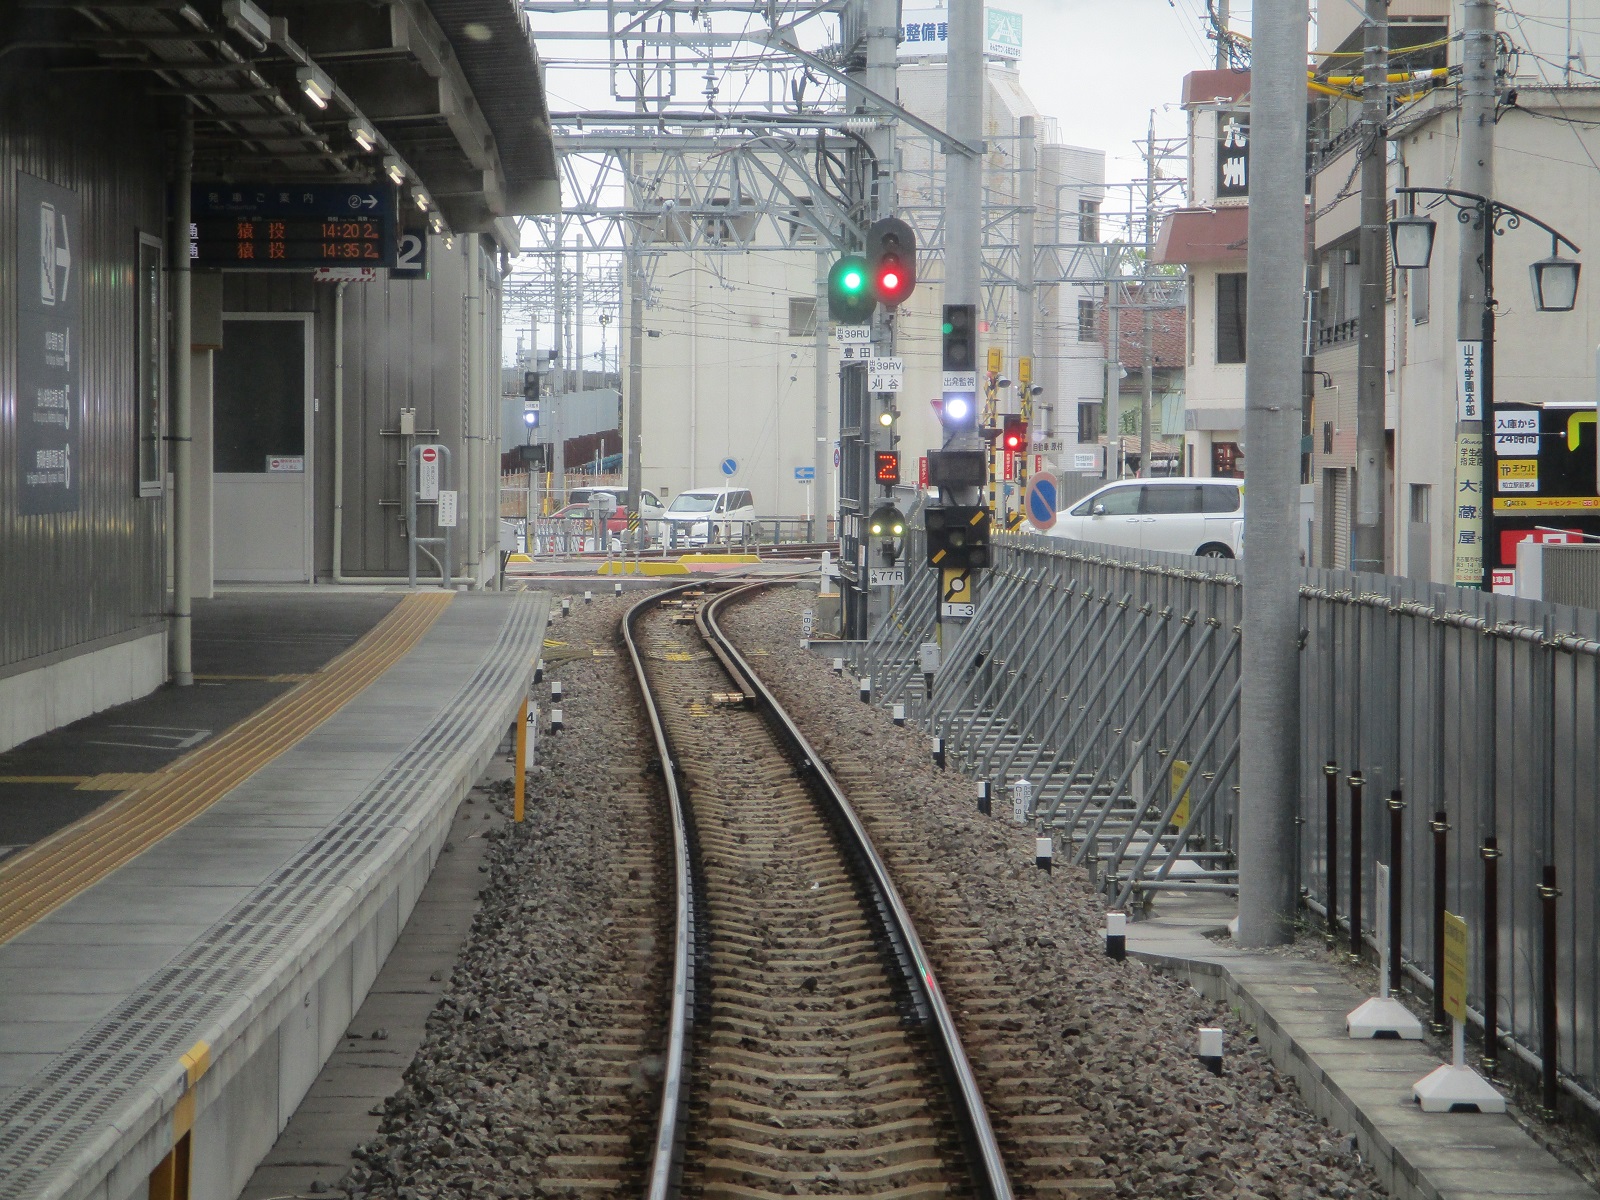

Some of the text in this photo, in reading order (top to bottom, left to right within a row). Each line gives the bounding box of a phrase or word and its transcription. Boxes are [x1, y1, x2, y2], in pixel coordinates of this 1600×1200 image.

[237, 222, 286, 239] 猿投
[322, 223, 359, 238] 14:20
[237, 242, 286, 259] 猿投
[322, 242, 359, 258] 14:35
[397, 234, 421, 269] 2
[844, 329, 869, 338] 39RU
[844, 347, 870, 358] 豊田
[876, 362, 901, 370] 39RV
[872, 378, 899, 390] 刈谷
[943, 376, 975, 387] 出発監視
[1463, 344, 1475, 417] 山本学園本部
[1497, 418, 1536, 429] 入庫から
[879, 455, 896, 478] 2
[1512, 464, 1535, 472] チケパ
[1458, 479, 1477, 545] 大蔵屋
[879, 571, 903, 581] 77R
